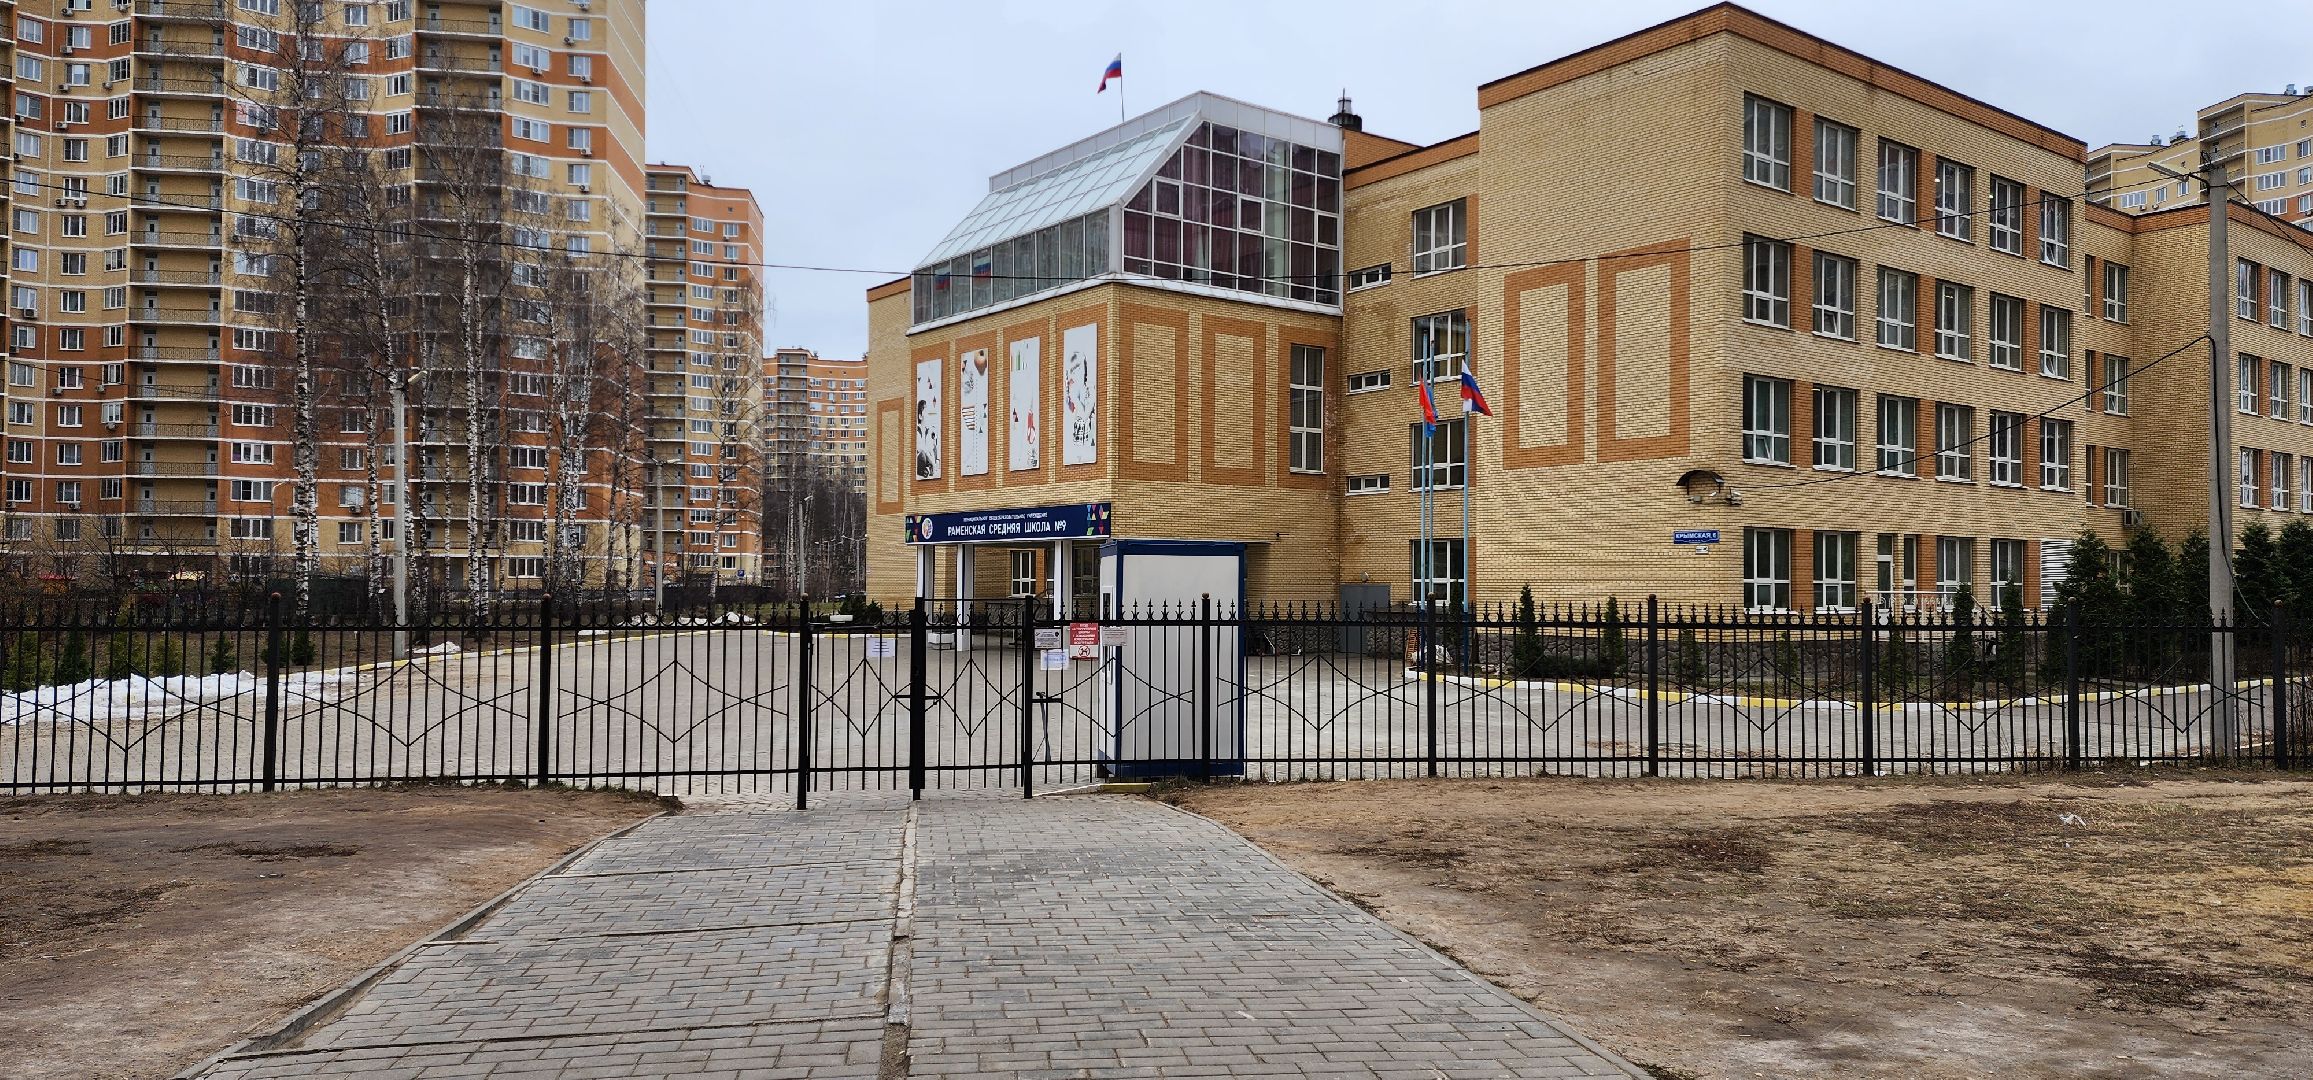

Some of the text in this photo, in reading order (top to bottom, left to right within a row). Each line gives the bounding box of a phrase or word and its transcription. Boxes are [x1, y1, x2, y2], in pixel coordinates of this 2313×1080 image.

[947, 520, 1067, 536] РАМЕНСКАЯ СРЕДНЯЯ ШКОЛА №9
